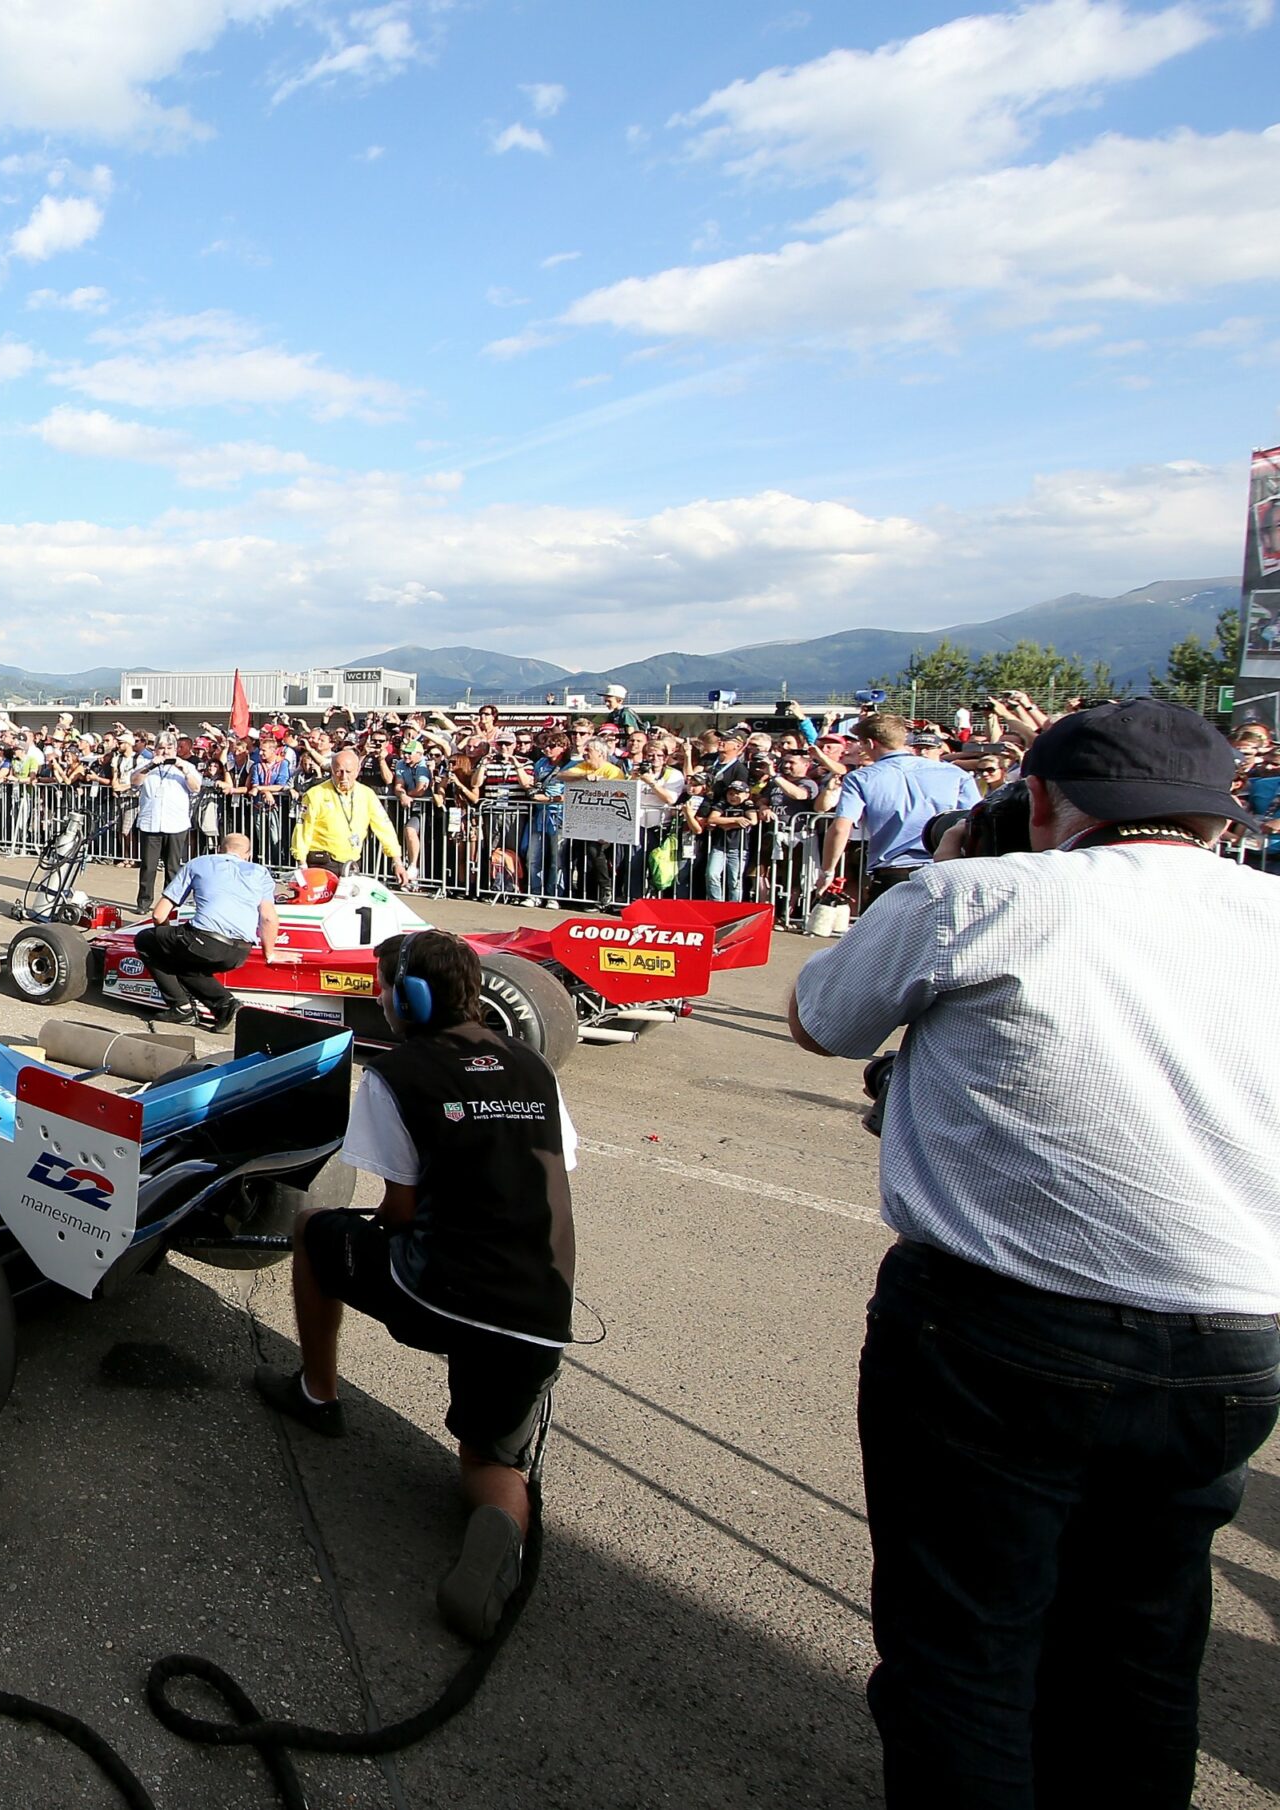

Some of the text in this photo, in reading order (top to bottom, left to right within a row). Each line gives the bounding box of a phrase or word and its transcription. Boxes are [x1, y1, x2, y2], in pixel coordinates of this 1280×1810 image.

[347, 672, 362, 680] WC
[355, 906, 372, 945] 1
[633, 954, 671, 970] Agip
[343, 977, 371, 990] Agip
[27, 1152, 115, 1212] D2
[21, 1194, 111, 1243] manesmann
